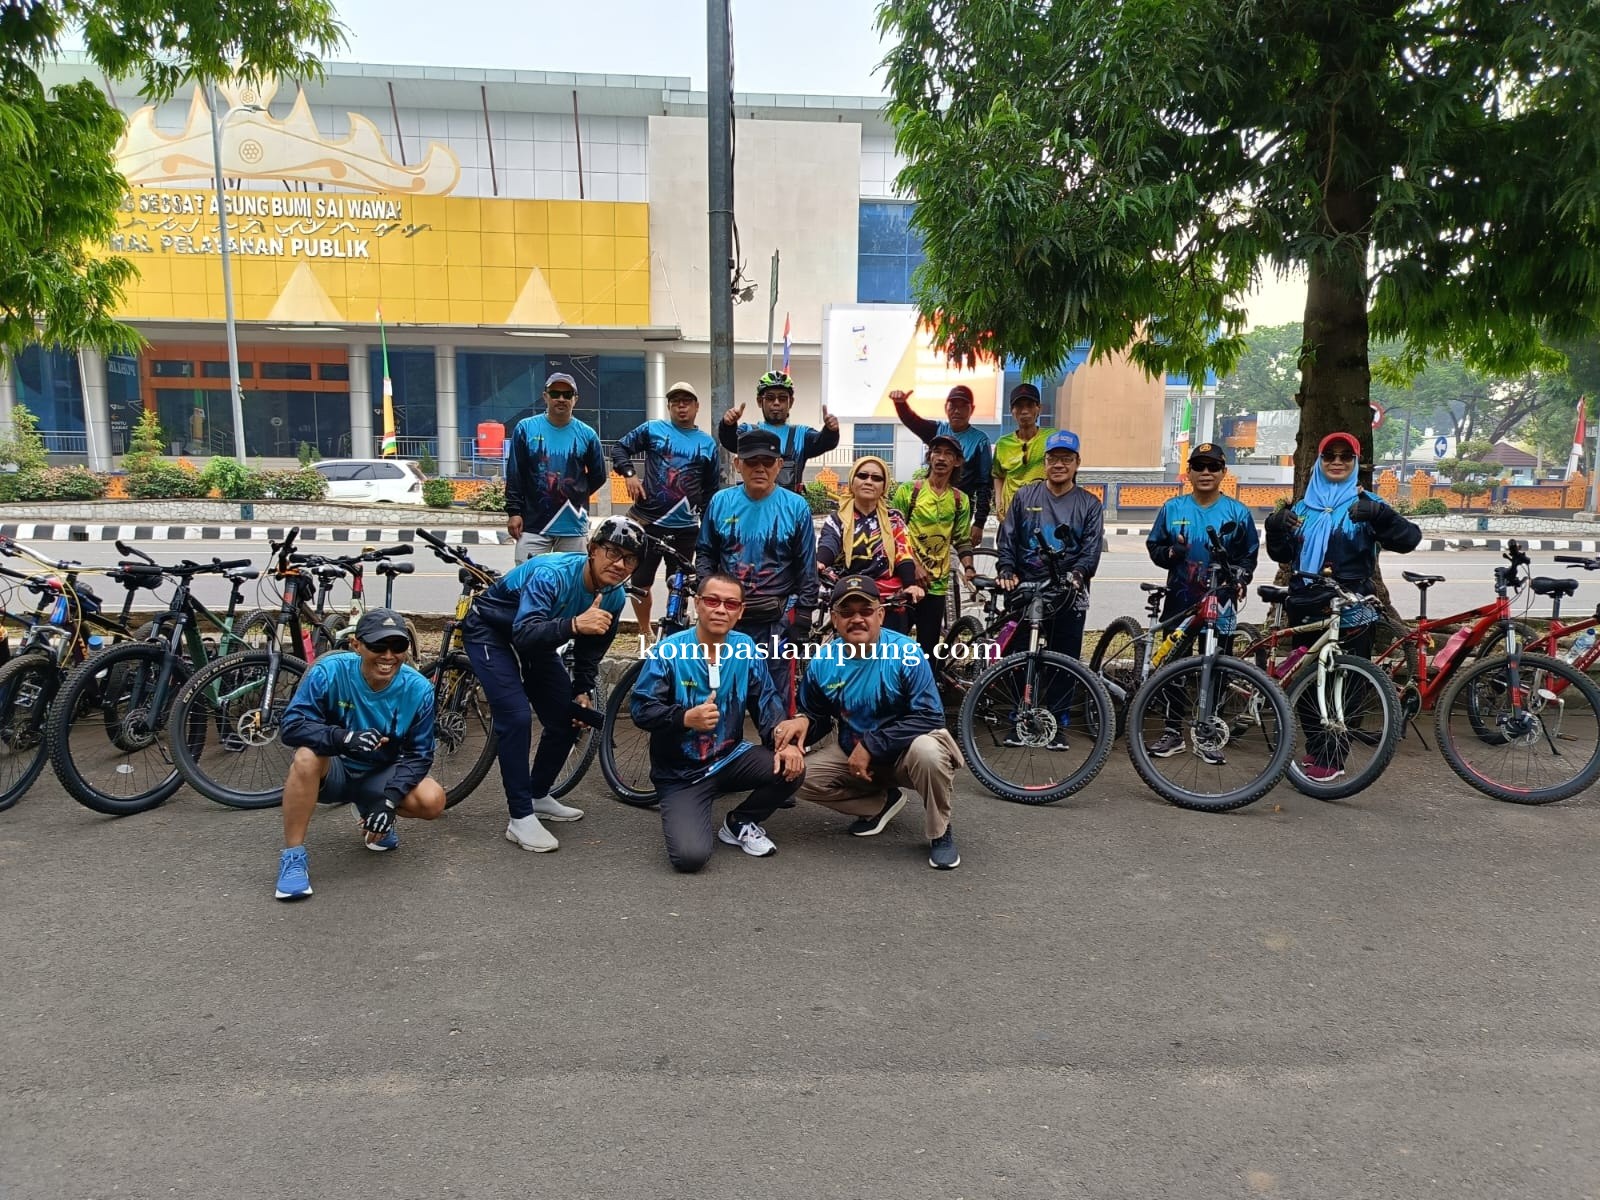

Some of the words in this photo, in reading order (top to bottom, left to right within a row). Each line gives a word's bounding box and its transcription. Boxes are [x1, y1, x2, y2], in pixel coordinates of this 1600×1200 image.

[209, 195, 268, 216] AGUNG
[271, 196, 312, 217] BUMI
[315, 198, 344, 219] SAI
[160, 234, 285, 256] PELAYANAN
[291, 238, 369, 257] PUBLIK
[194, 671, 212, 689] JACK
[212, 657, 245, 673] RABBIT
